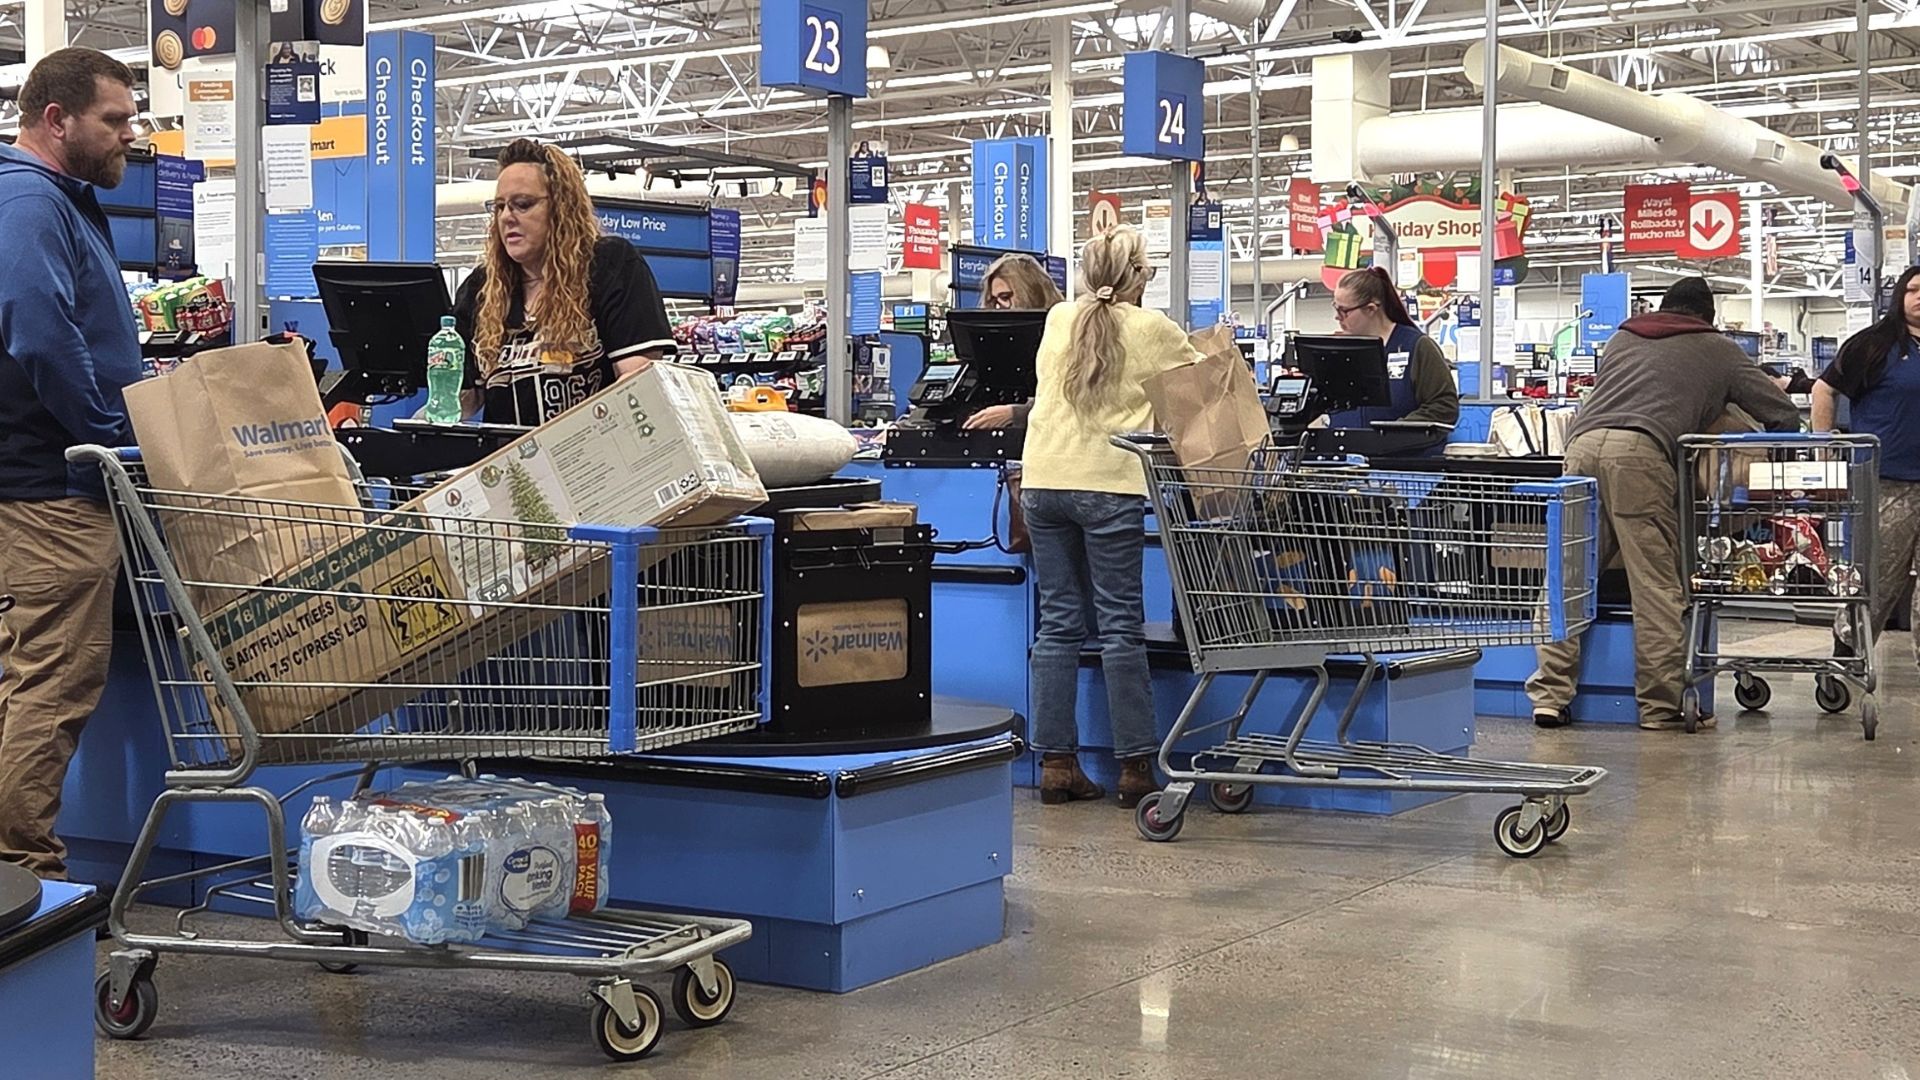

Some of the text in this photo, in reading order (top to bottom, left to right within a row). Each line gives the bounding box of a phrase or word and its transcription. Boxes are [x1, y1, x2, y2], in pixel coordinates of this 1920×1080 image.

[804, 16, 841, 74] 23
[375, 57, 391, 165] Checkout
[411, 59, 427, 165] Checkout
[1158, 99, 1185, 145] 24
[994, 162, 1008, 241] Checkout
[1020, 163, 1030, 241] Checkout
[1637, 208, 1678, 218] Miles de
[621, 214, 641, 229] Low
[642, 216, 667, 232] Price
[1368, 219, 1482, 239] Hliday Shop
[1630, 219, 1677, 229] Rollbacks
[1630, 229, 1686, 240] mucho más
[1859, 266, 1871, 285] 14
[232, 414, 331, 448] Walmart
[392, 571, 422, 596] TEAM
[236, 600, 335, 668] ARTIFICIAL TREES
[292, 626, 345, 667] CYPRESS
[343, 613, 368, 638] LED
[831, 630, 904, 655] Walmart
[577, 834, 598, 848] 40
[575, 864, 587, 898] PACK
[583, 862, 597, 899] VALUE
